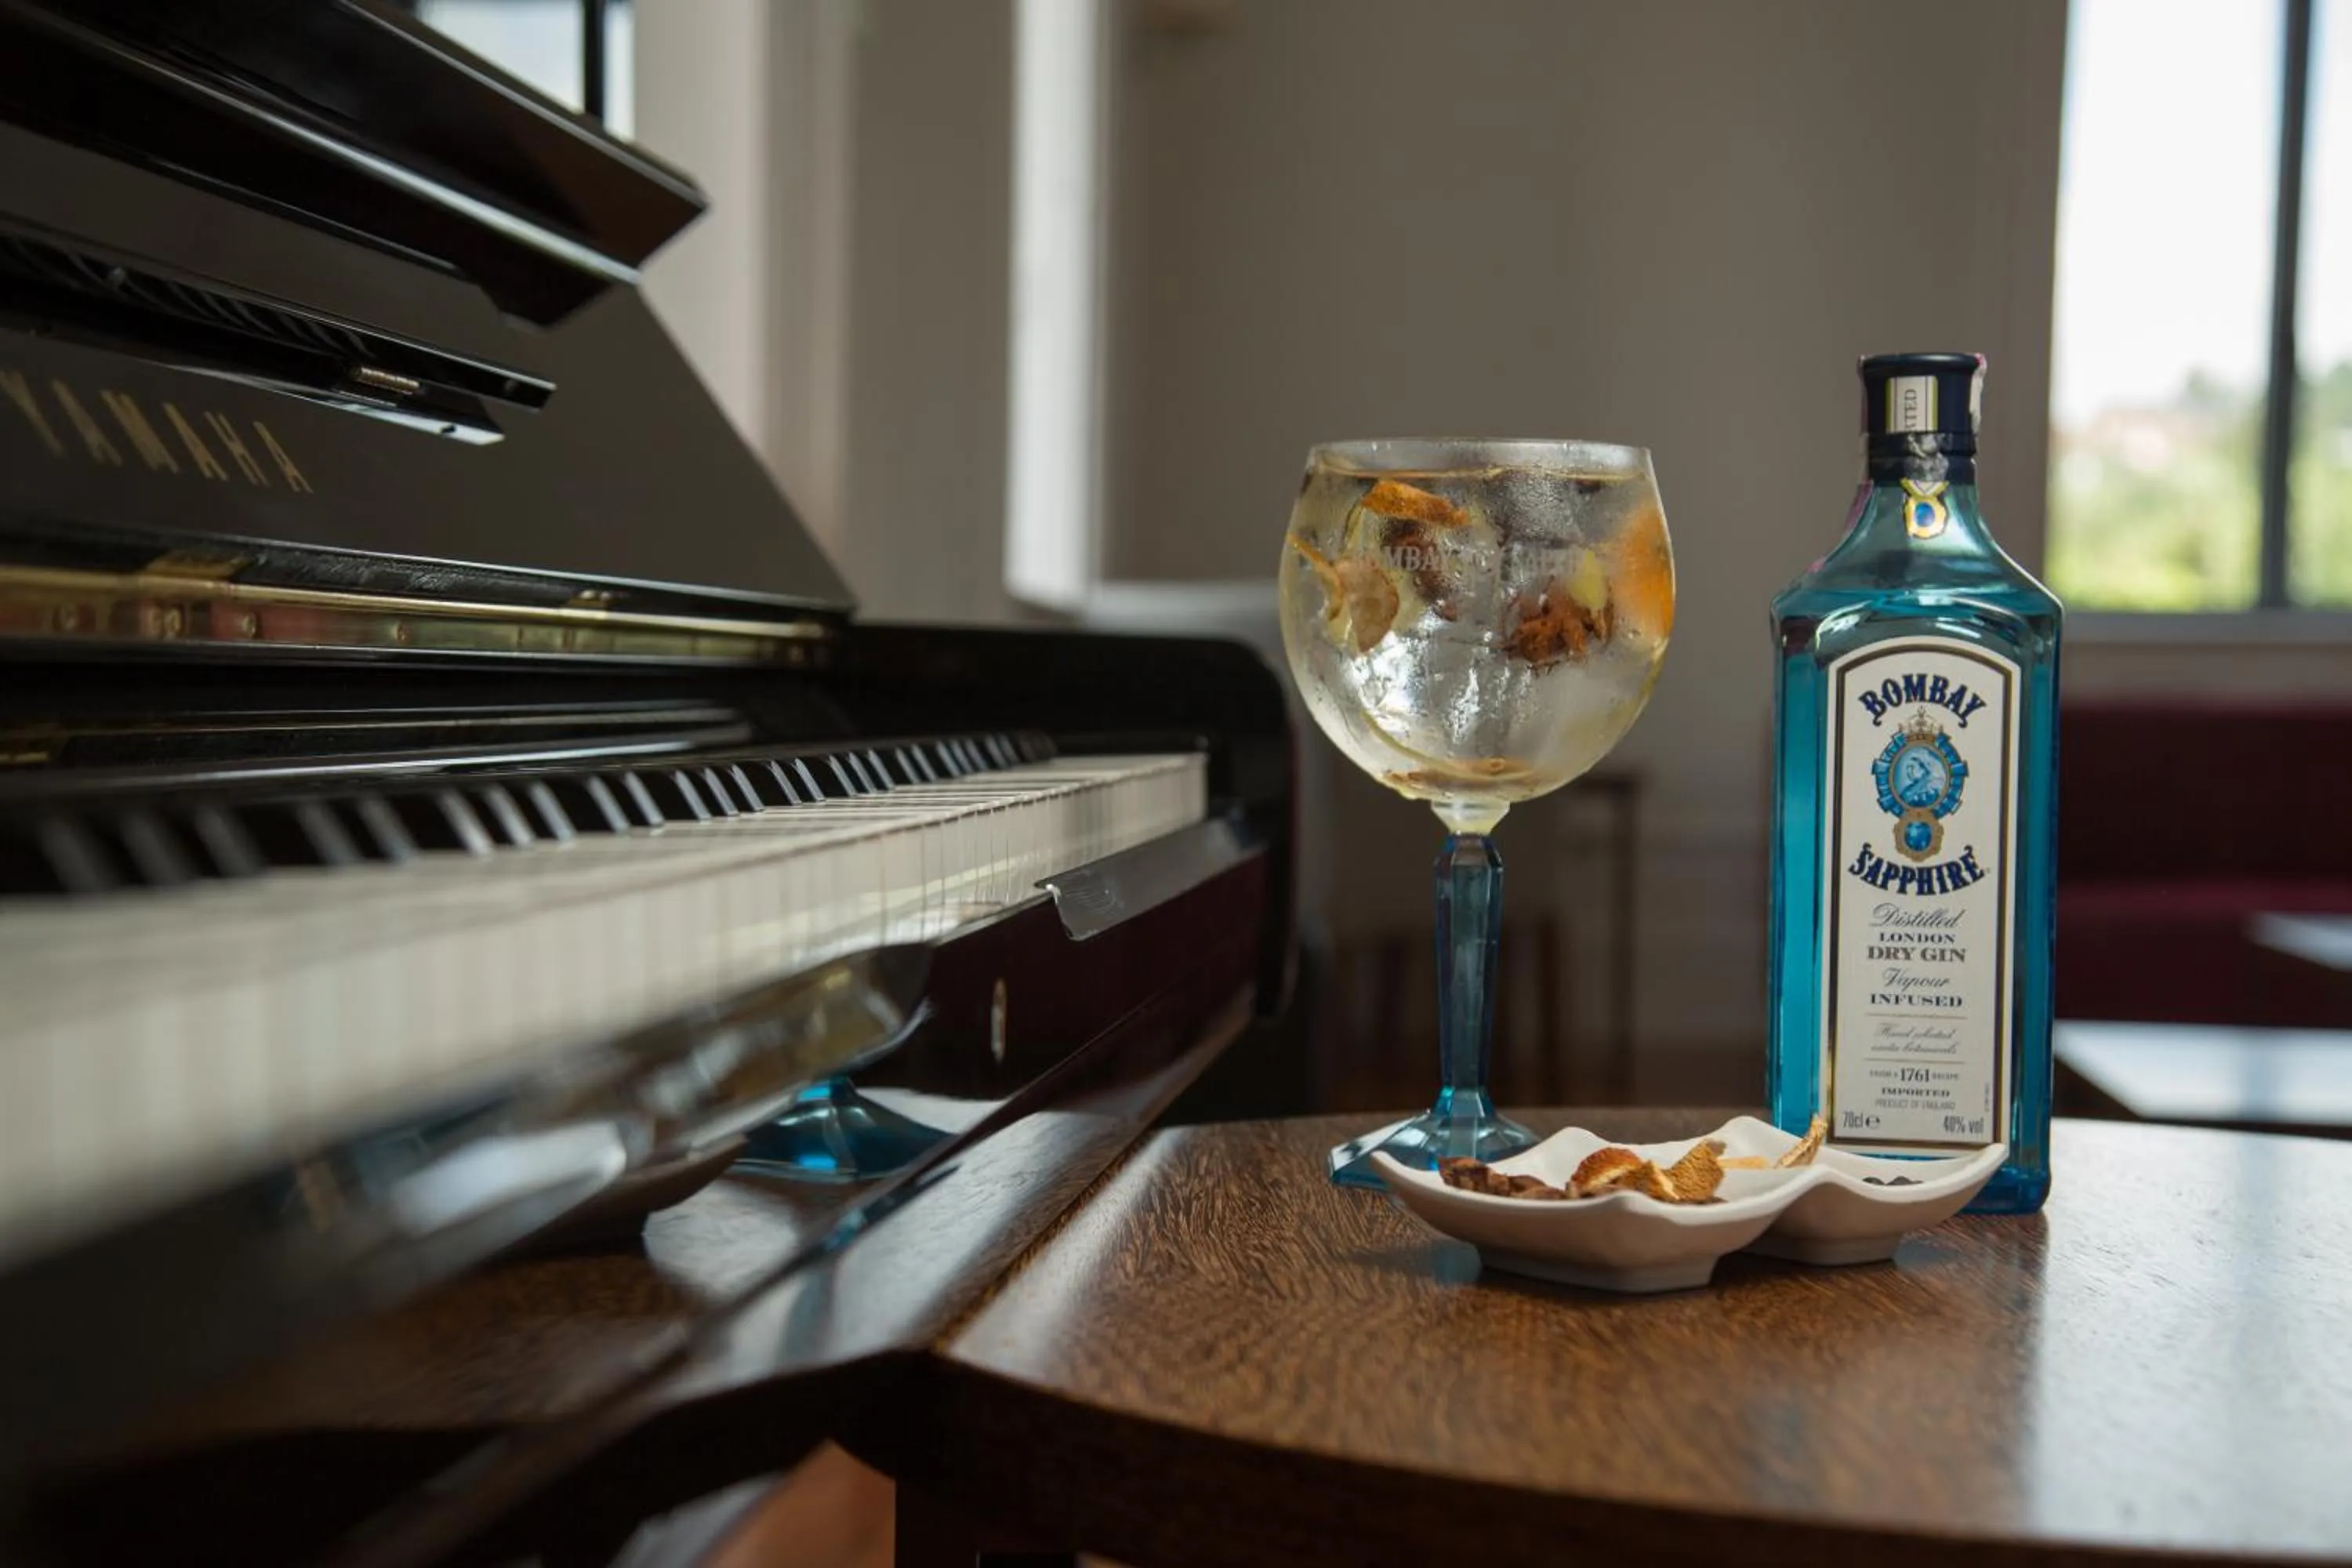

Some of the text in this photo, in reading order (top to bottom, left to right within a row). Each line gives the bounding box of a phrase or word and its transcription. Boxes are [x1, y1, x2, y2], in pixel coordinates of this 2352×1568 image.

[1858, 673, 1987, 728] BOMBAY
[1847, 841, 1985, 895] SAPPHIRE
[1868, 902, 1966, 928] Distilled
[1879, 931, 1956, 944] LONDON
[1867, 945, 1966, 964] DRY GIN
[1882, 967, 1951, 993] Vapour
[1870, 993, 1963, 1007] INFUSED
[1900, 1067, 1930, 1083] 1761
[1882, 1087, 1951, 1098] IMPORTED
